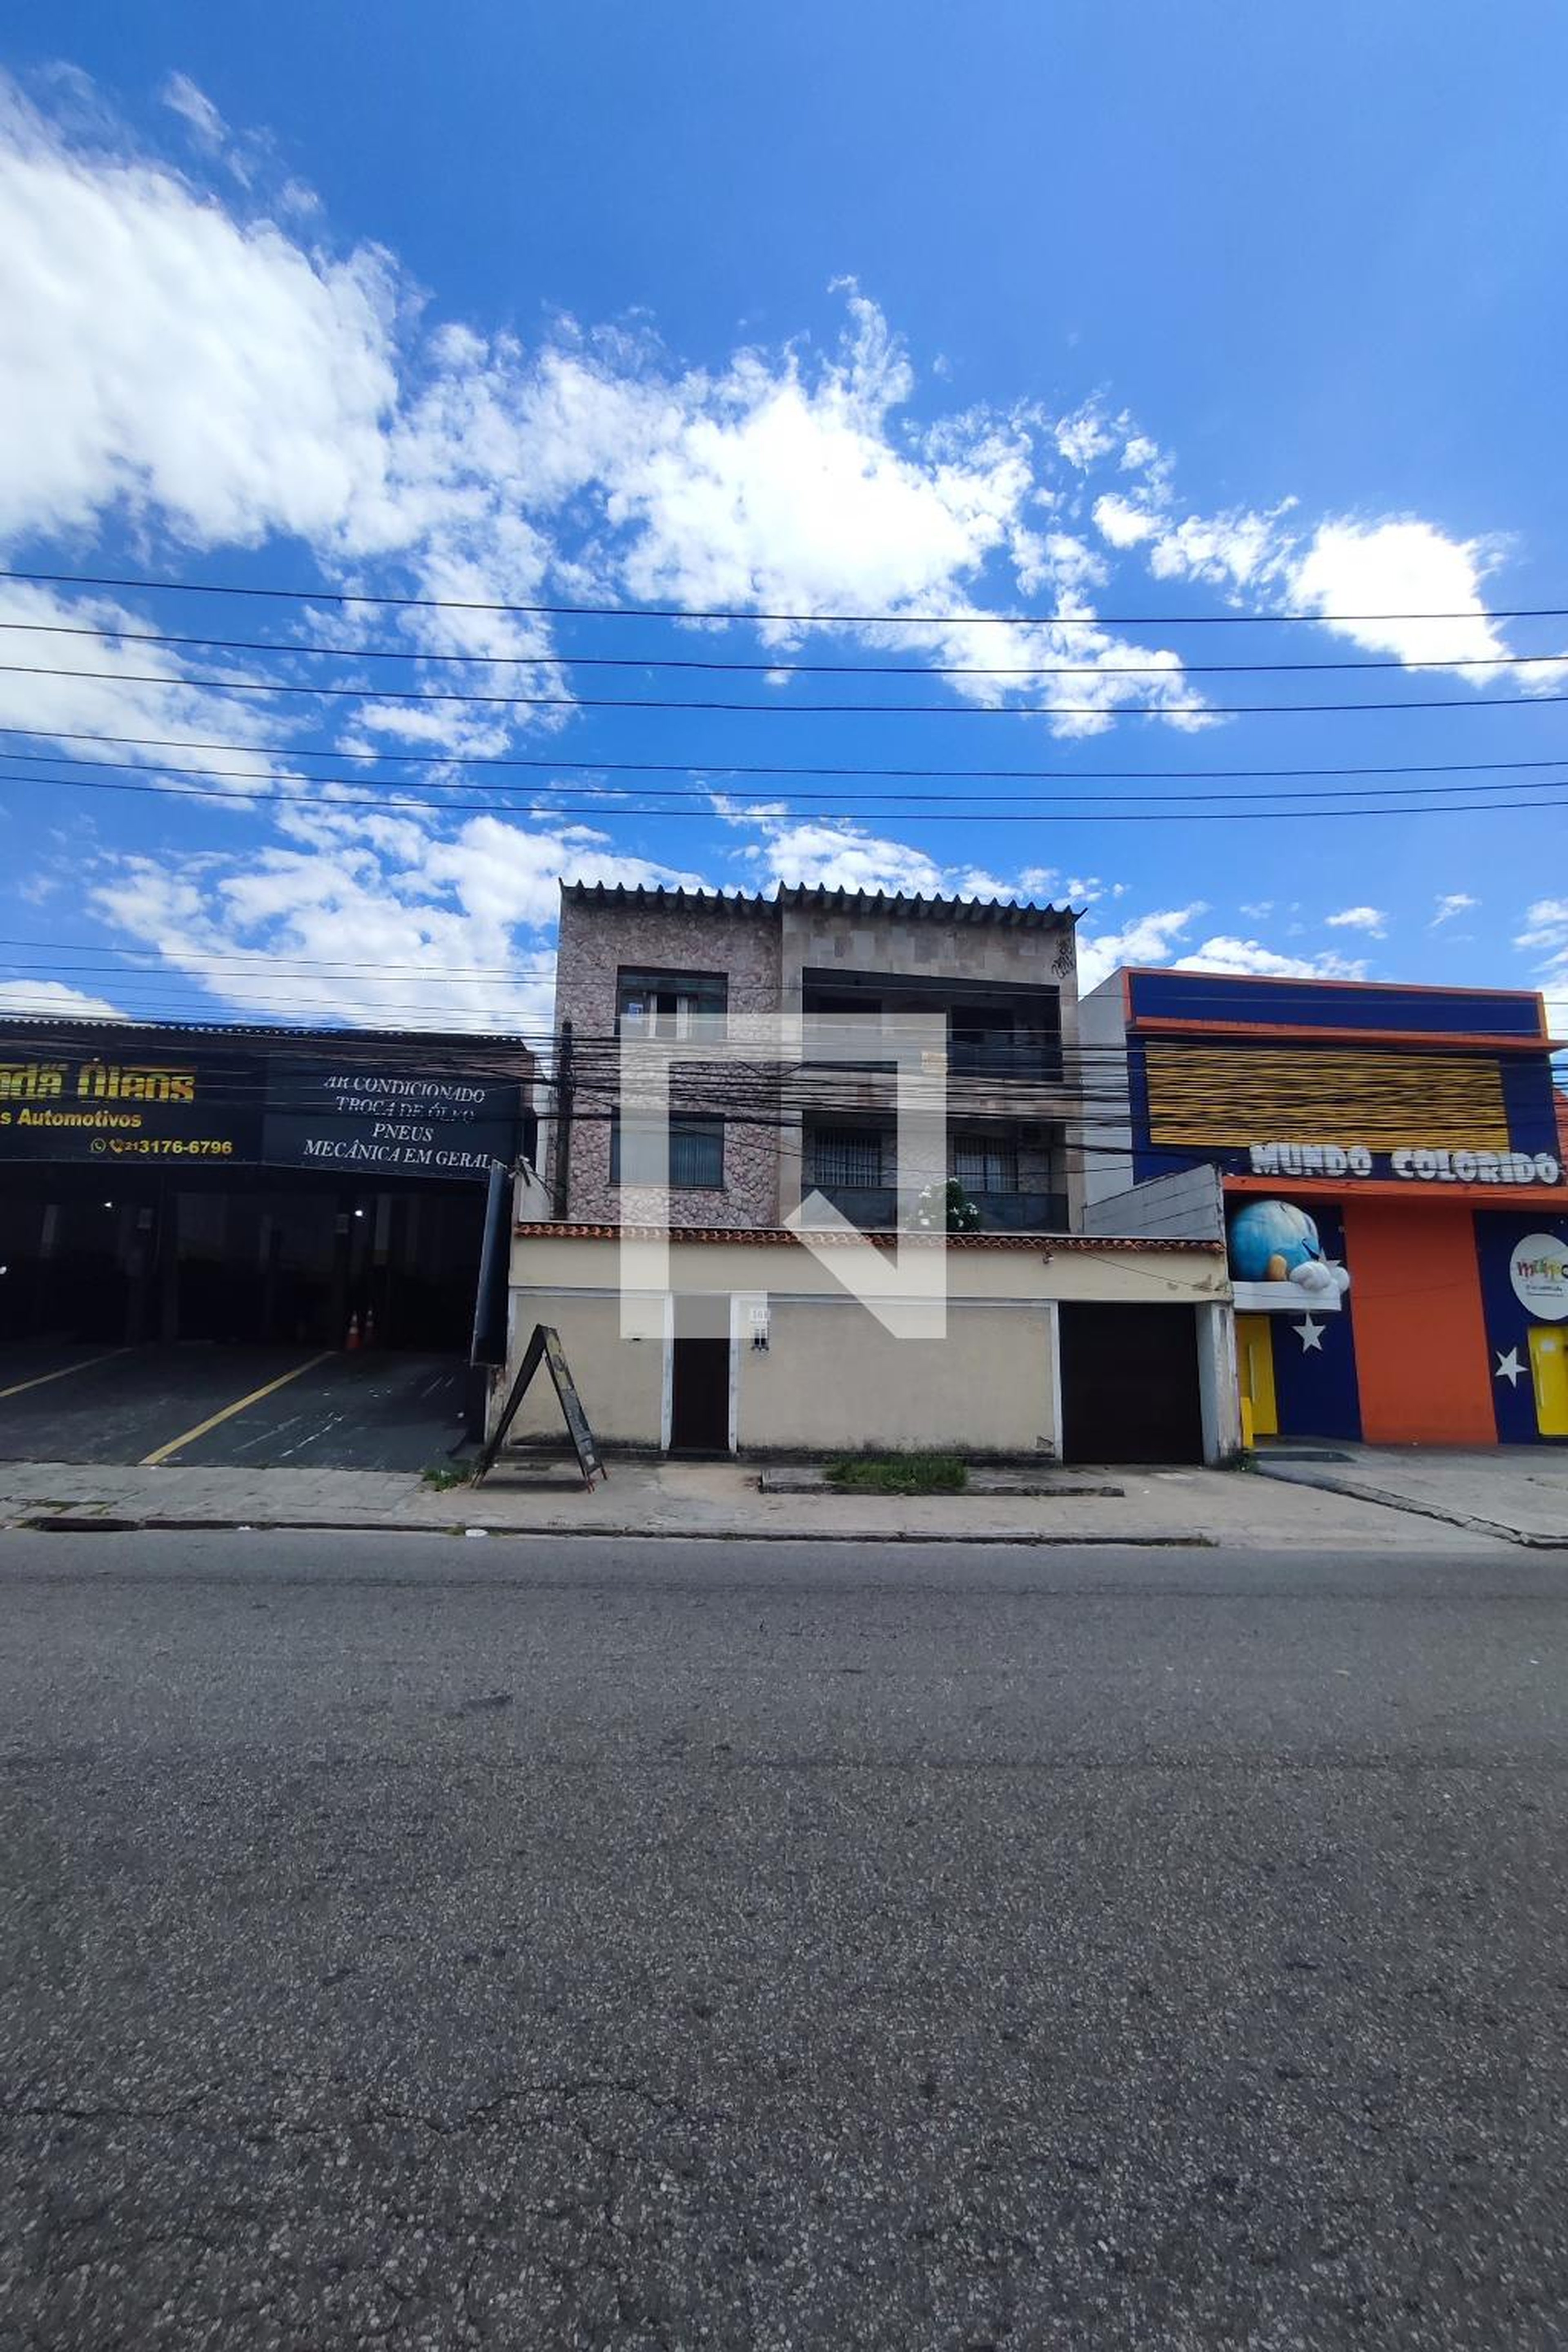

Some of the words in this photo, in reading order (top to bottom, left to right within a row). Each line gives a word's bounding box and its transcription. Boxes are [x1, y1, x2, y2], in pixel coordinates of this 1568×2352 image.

[324, 1076, 348, 1089] AR
[354, 1078, 486, 1103] CONDICIONADO
[18, 1109, 142, 1127] Automotivos
[372, 1123, 434, 1142] PNEUS
[139, 1140, 233, 1154] 3176-6796
[303, 1139, 400, 1162] MECÂNICA
[403, 1148, 433, 1165] EM
[436, 1151, 490, 1169] GERAL
